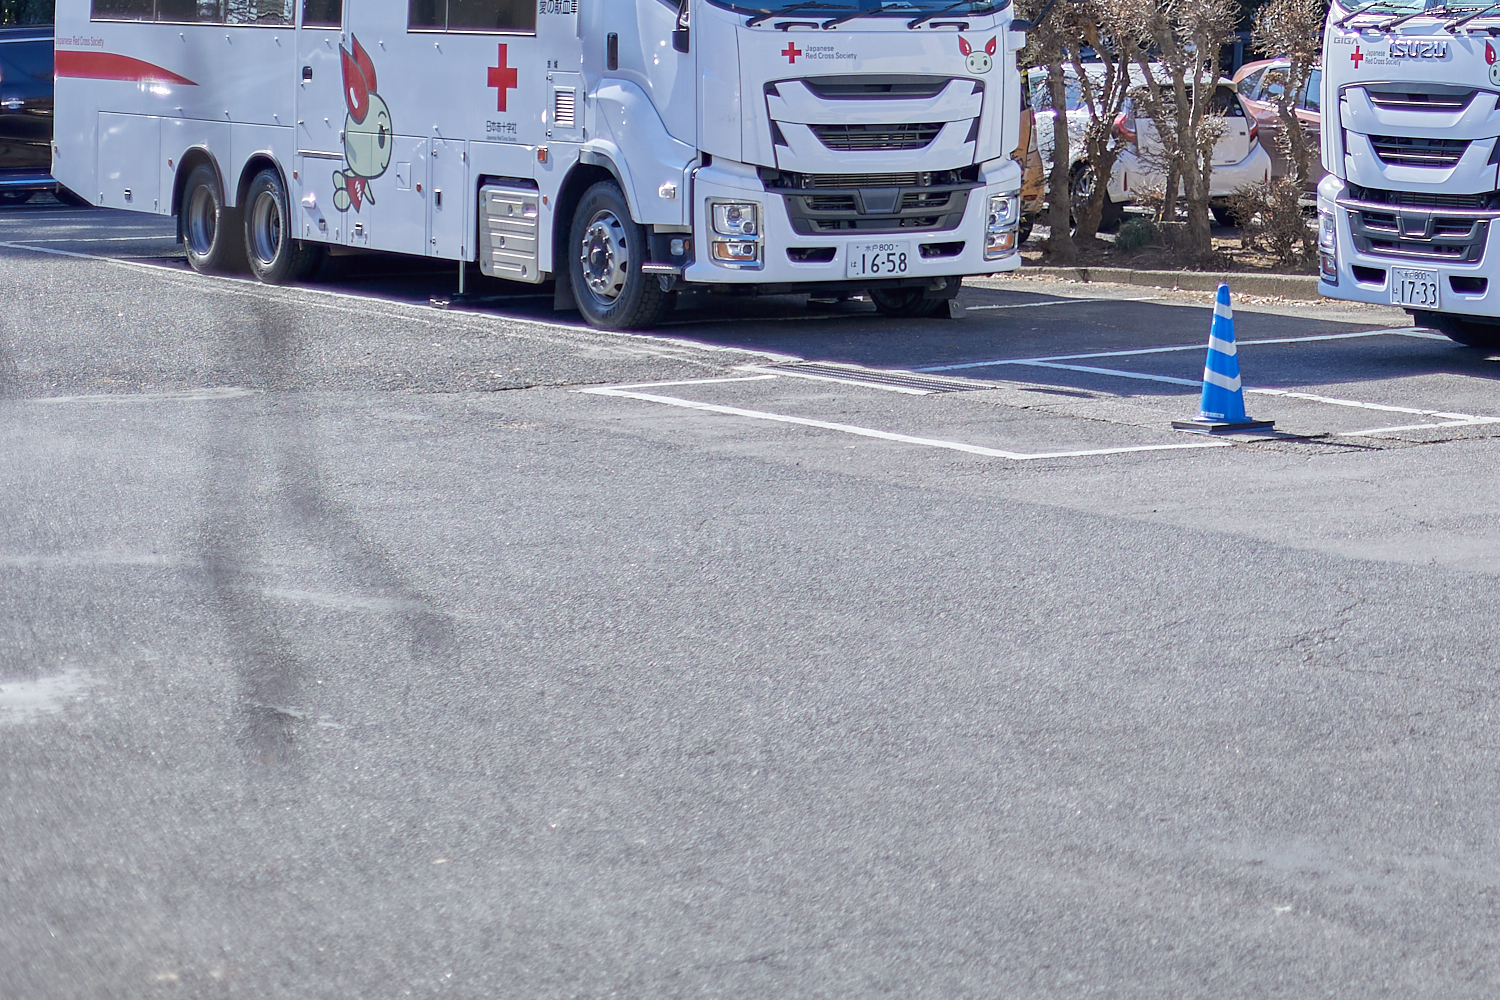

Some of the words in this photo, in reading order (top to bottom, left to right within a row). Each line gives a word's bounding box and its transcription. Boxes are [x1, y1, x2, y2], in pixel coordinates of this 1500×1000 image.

[1333, 36, 1359, 45] GIGA
[805, 45, 834, 53] Japanese
[1389, 39, 1448, 59] ISUZU
[805, 52, 817, 60] Red
[818, 52, 834, 60] Cross
[836, 51, 857, 60] Society
[879, 243, 894, 251] 800
[862, 252, 907, 274] 16-58
[1401, 280, 1437, 305] 17-33
